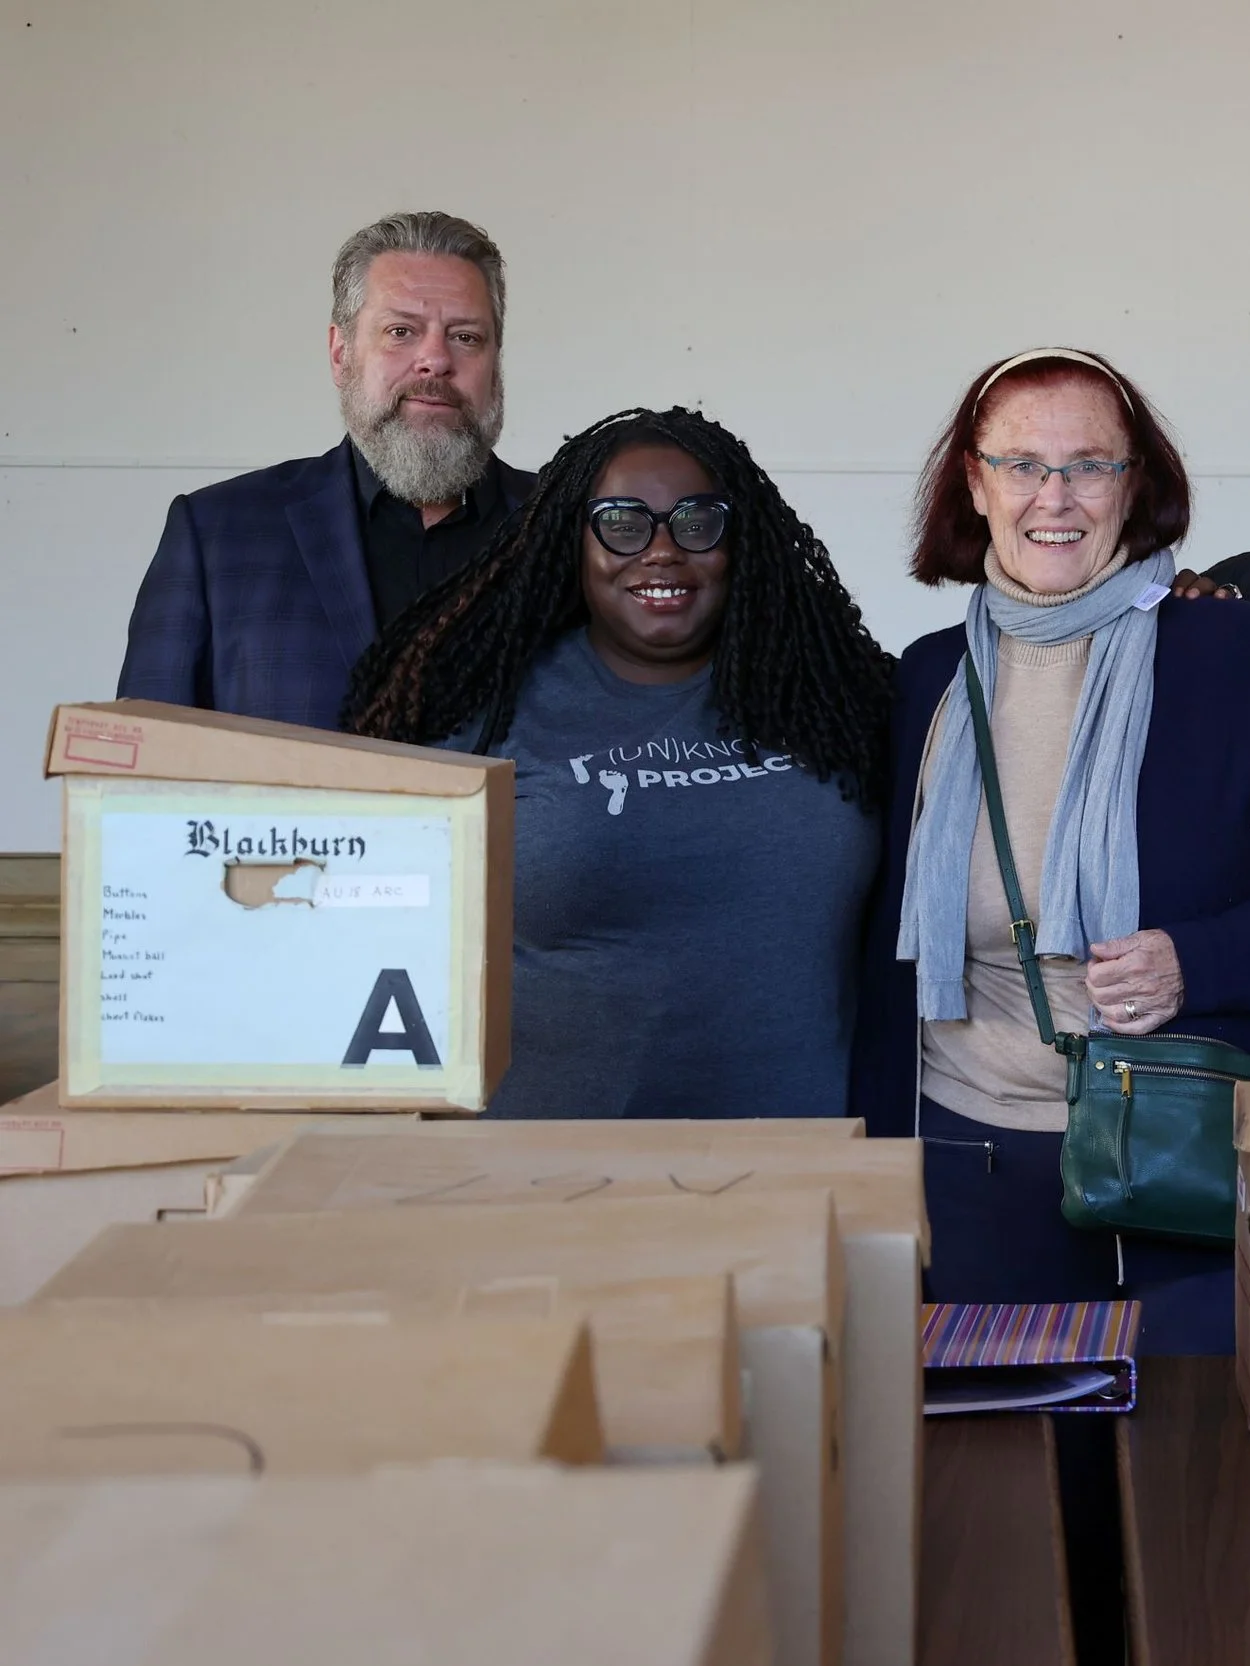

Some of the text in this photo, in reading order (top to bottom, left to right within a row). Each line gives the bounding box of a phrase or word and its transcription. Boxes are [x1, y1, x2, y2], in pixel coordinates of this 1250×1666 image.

[637, 755, 792, 788] PROJEC
[184, 820, 366, 861] Blackburn
[340, 968, 443, 1071] A
